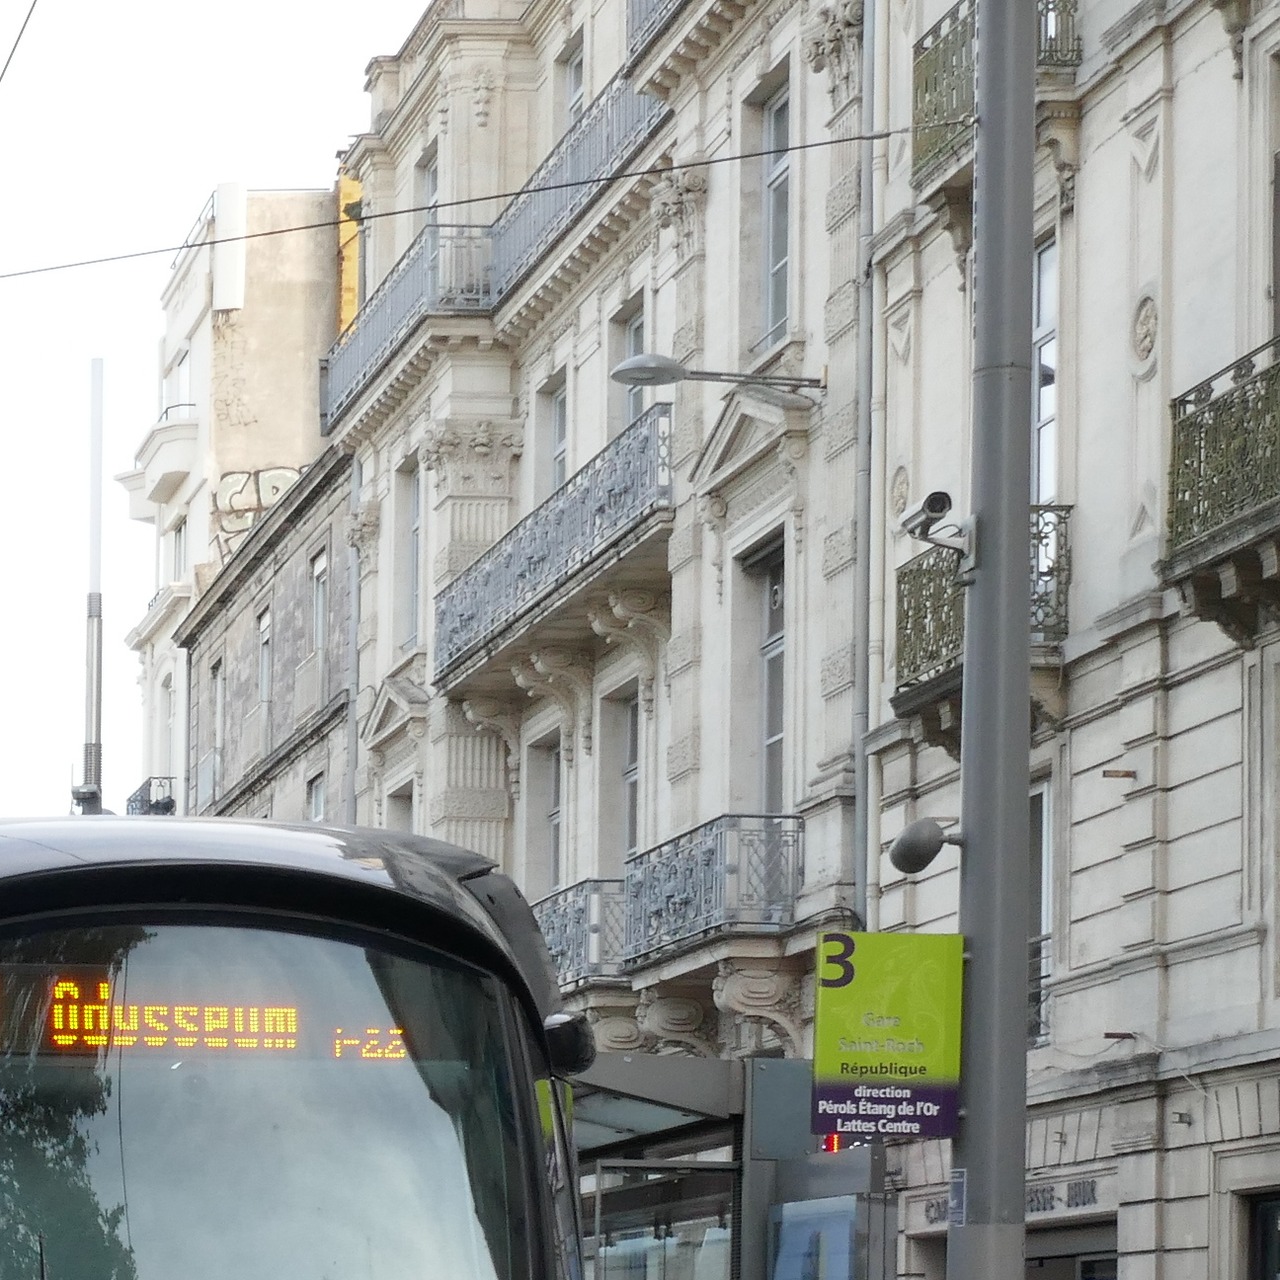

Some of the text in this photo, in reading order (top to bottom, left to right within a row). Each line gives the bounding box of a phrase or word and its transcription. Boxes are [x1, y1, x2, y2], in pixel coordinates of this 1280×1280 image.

[819, 932, 856, 988] 3
[840, 1062, 927, 1078] République
[854, 1085, 911, 1099] direction
[818, 1098, 940, 1118] Pérols Étang de l'Or
[836, 1118, 921, 1134] Lattes Centre
